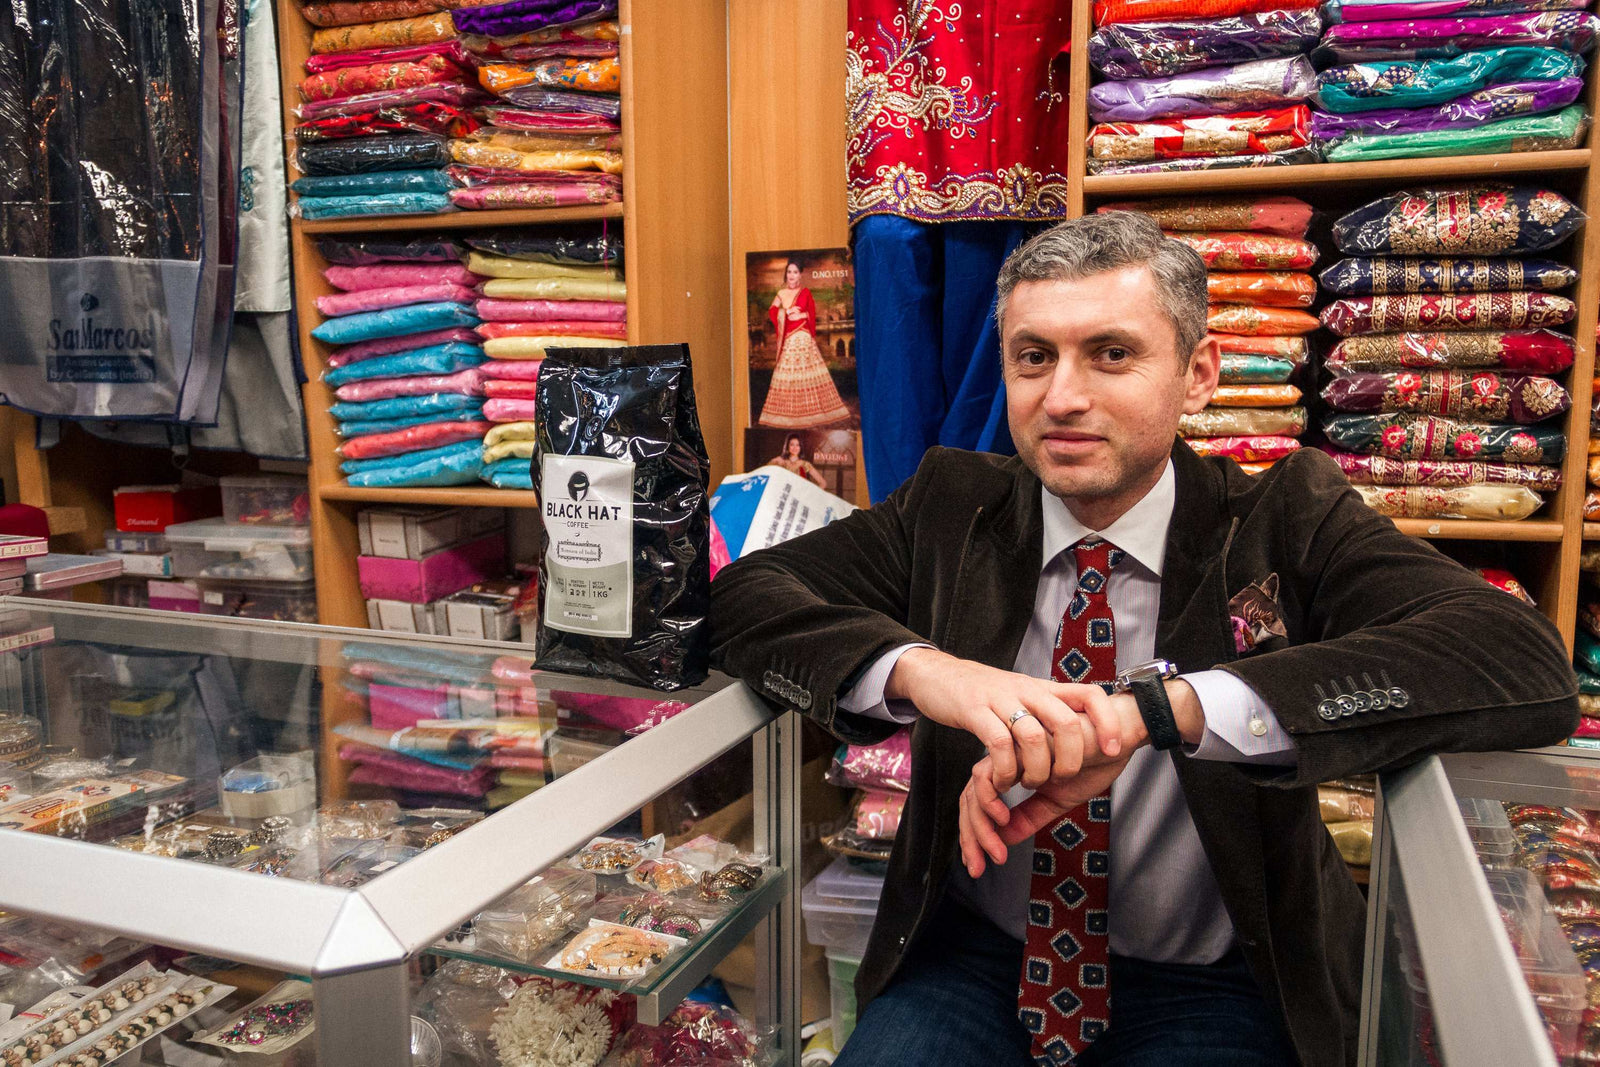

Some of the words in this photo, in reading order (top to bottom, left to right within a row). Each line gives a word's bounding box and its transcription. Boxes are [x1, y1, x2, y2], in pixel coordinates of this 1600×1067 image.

[50, 369, 63, 380] by
[546, 502, 582, 519] BLACK
[588, 505, 621, 520] HAT
[127, 518, 159, 526] Diamond
[566, 521, 589, 529] COFFEE
